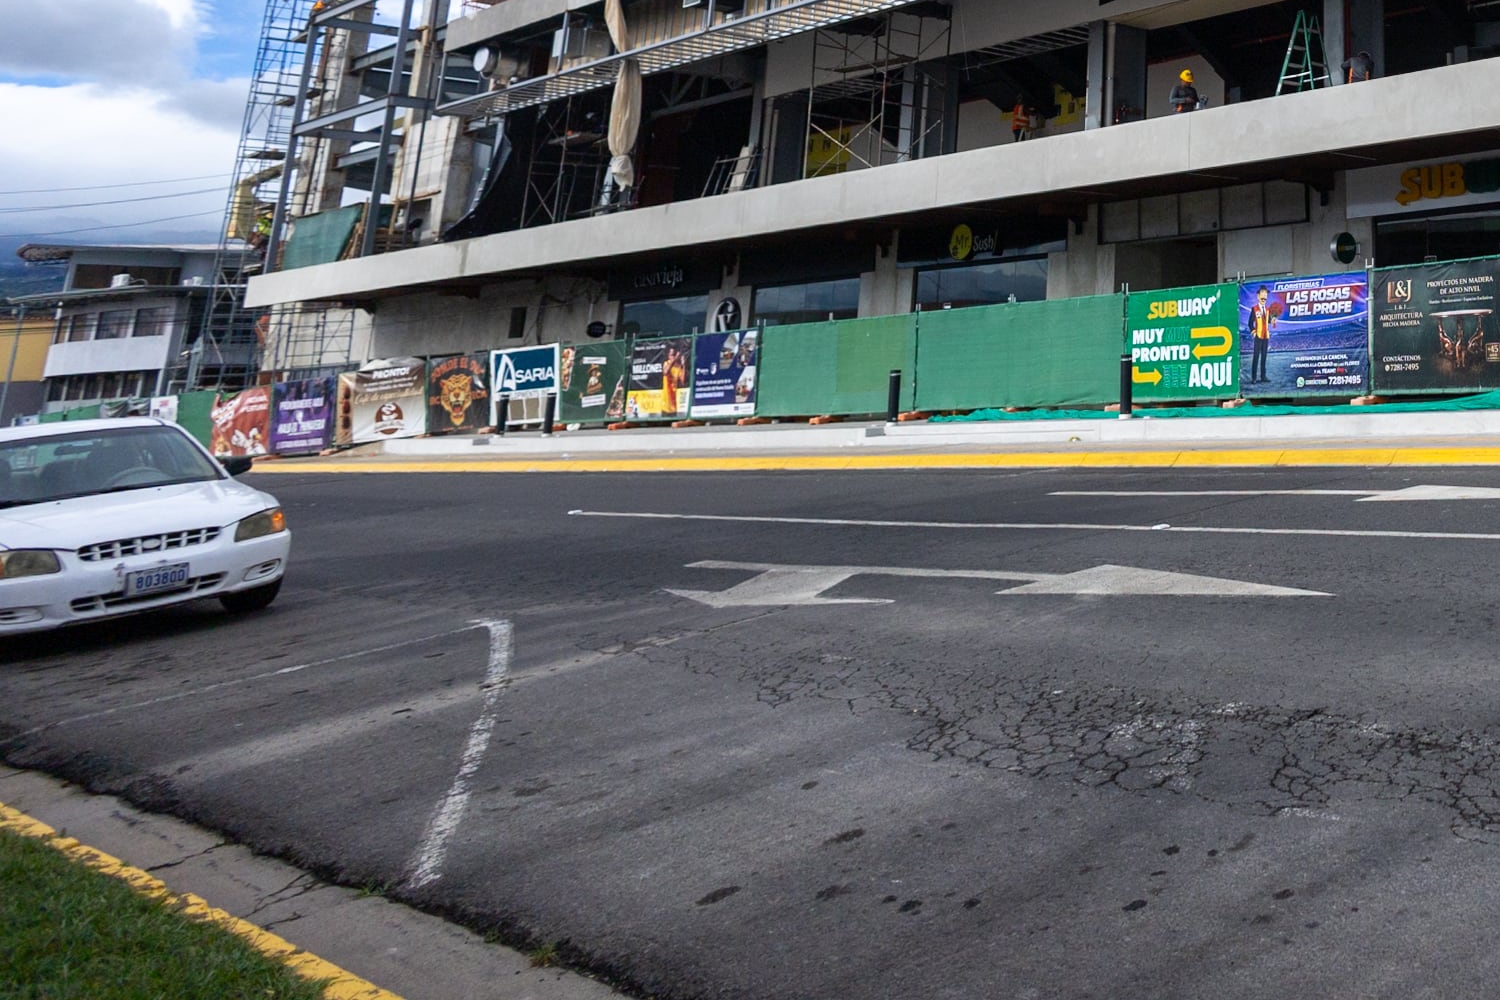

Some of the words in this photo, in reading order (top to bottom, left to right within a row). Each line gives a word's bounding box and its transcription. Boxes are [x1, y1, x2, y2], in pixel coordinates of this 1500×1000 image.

[1427, 279, 1459, 288] PROYECTOS
[1468, 275, 1494, 284] MADERA
[1448, 286, 1463, 294] ALTO
[1286, 290, 1308, 304] LAS
[1310, 287, 1351, 302] ROSAS
[1147, 293, 1219, 320] SUBWAY
[1289, 303, 1312, 317] DEL
[1313, 301, 1353, 315] PROFE
[1380, 312, 1423, 321] ARQUITECTURA
[1132, 328, 1165, 345] MUY
[1132, 345, 1190, 363] PRONTO
[496, 353, 554, 392] ASARIA
[1189, 356, 1233, 390] AQUÍ
[1390, 363, 1419, 371] 7281-7495
[136, 569, 185, 588] 803800
